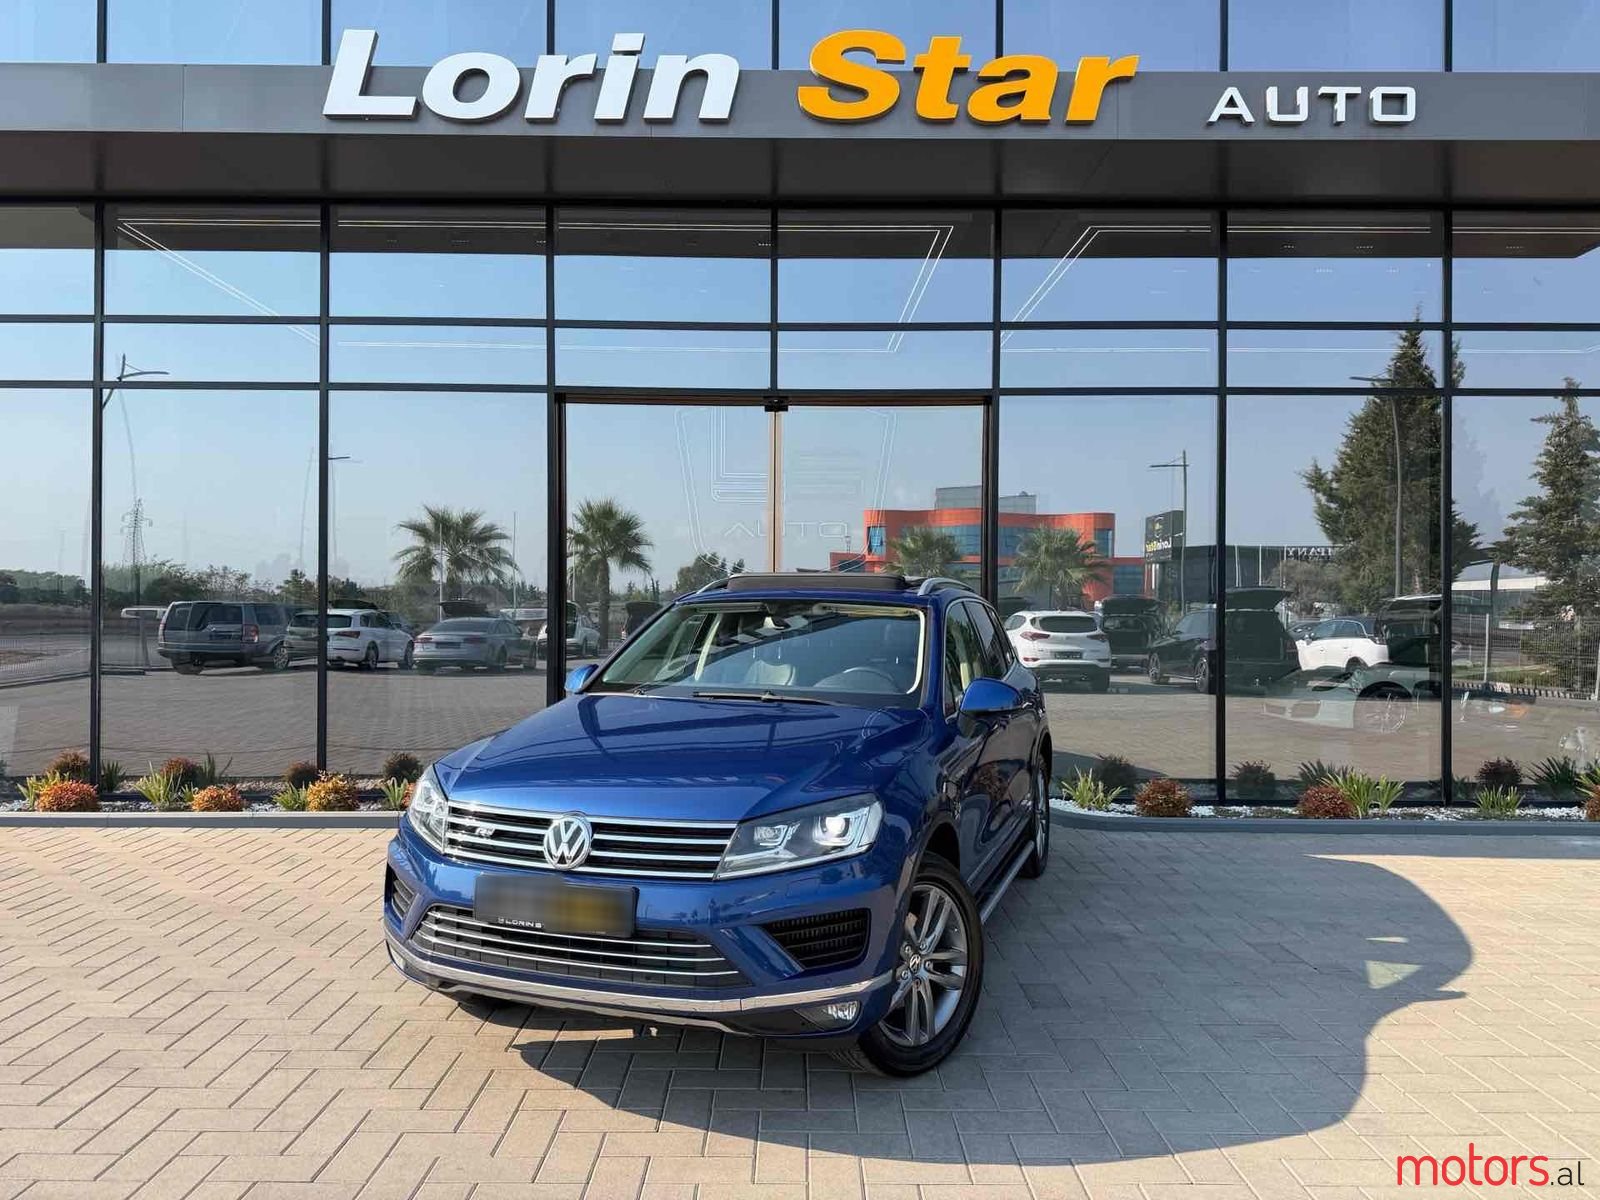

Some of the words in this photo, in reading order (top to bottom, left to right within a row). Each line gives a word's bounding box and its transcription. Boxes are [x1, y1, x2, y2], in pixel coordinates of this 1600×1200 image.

[323, 29, 740, 123] Lorin
[797, 29, 1139, 125] Star
[1207, 86, 1417, 126] AUTO
